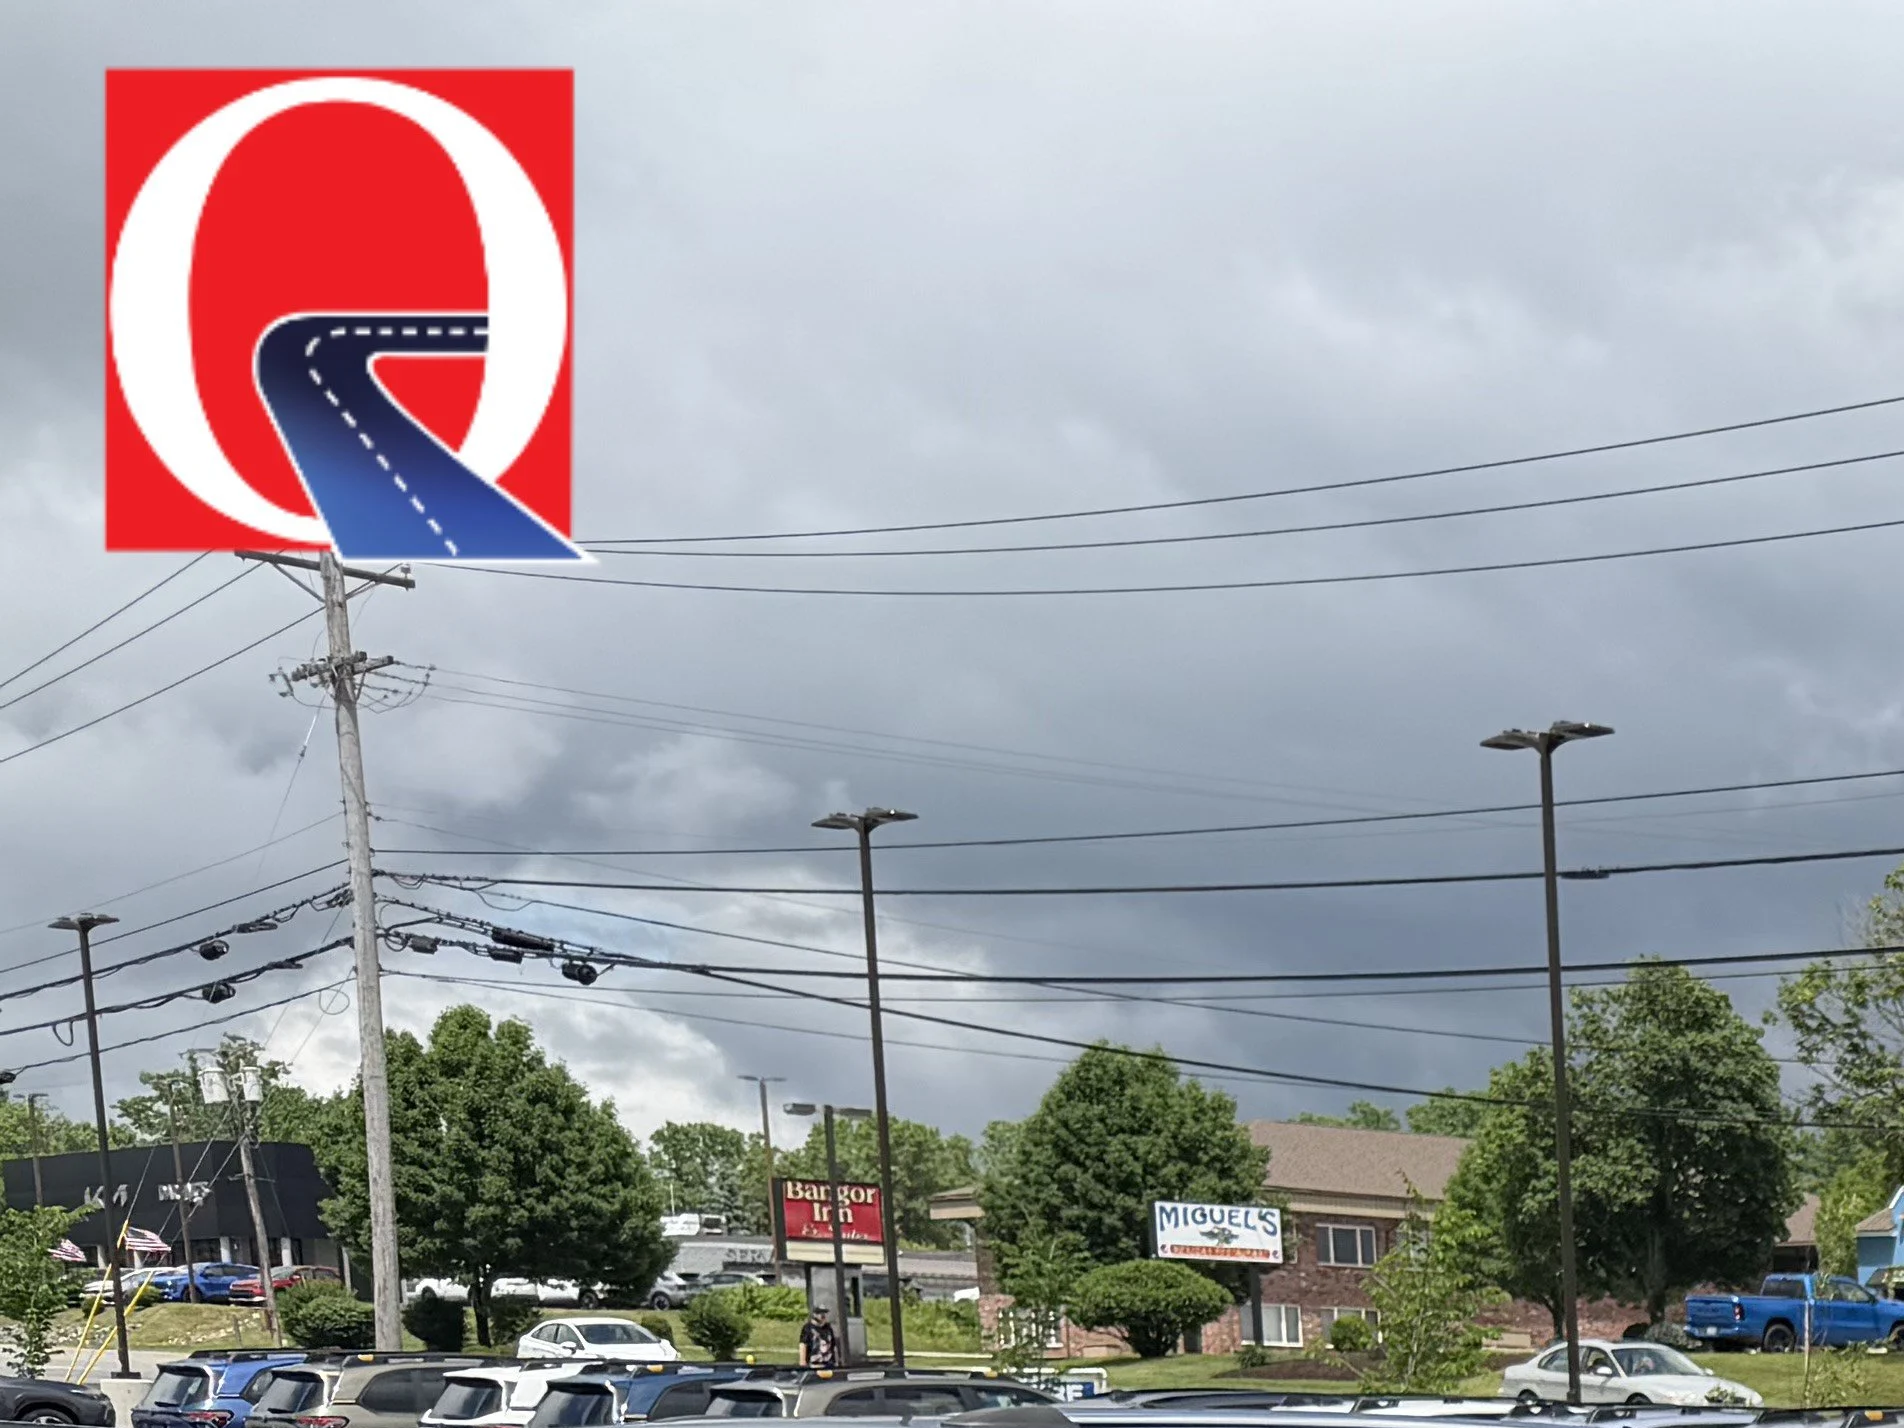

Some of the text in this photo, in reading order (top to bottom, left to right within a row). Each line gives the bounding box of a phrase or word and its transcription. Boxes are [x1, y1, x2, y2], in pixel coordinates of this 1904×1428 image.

[786, 1181, 877, 1208] Bangor
[813, 1203, 853, 1223] Inn
[1159, 1205, 1278, 1237] MIGUEL'S
